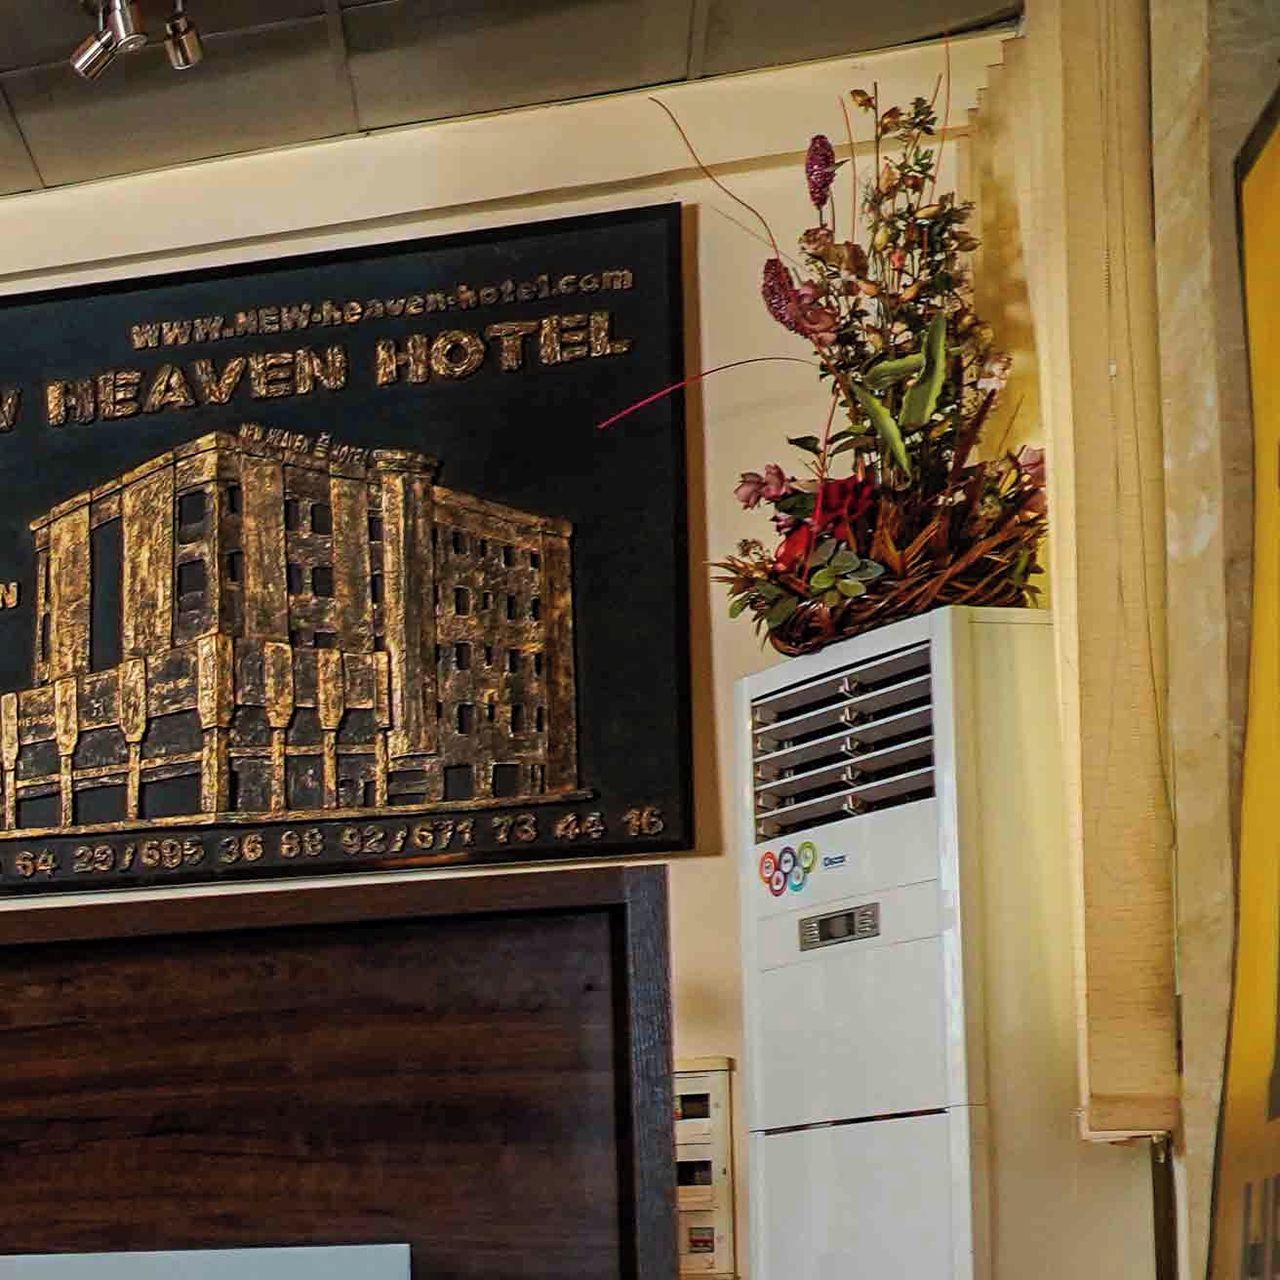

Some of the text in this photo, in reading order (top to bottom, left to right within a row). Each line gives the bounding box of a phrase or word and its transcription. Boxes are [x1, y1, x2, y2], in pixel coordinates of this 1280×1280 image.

[46, 344, 349, 427] HEAVEN
[375, 311, 634, 387] HOTEL
[218, 832, 264, 865] 36
